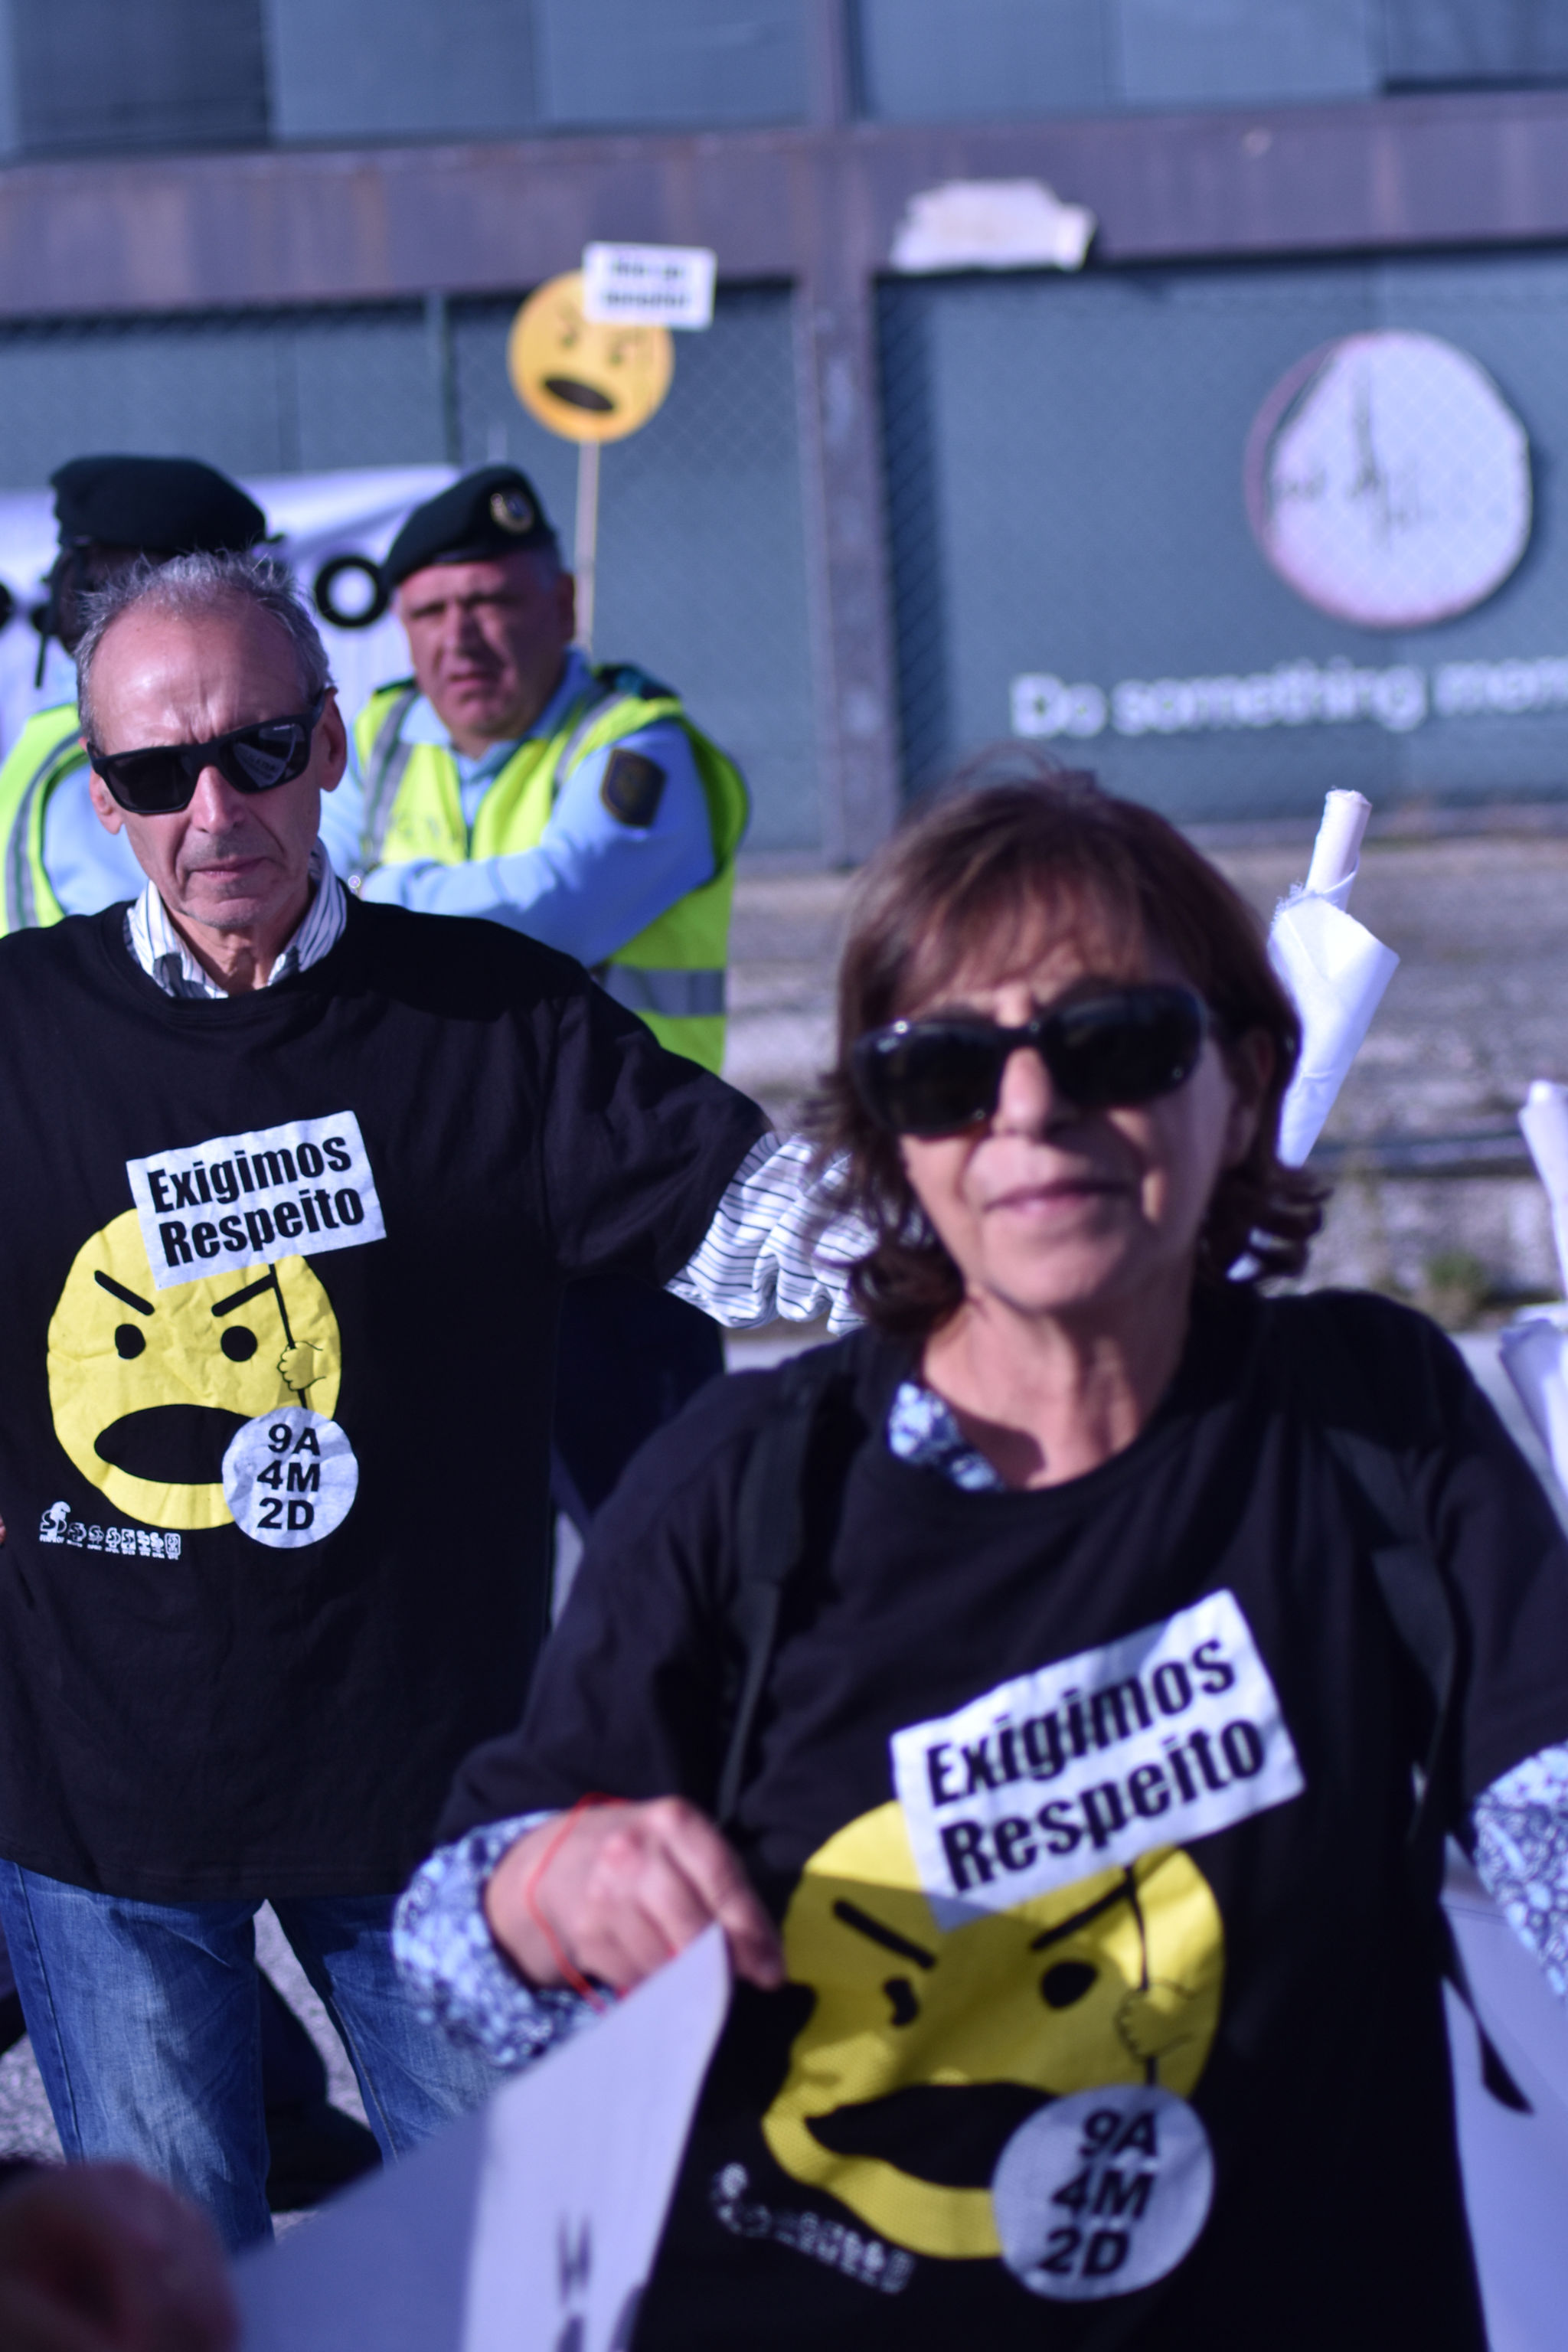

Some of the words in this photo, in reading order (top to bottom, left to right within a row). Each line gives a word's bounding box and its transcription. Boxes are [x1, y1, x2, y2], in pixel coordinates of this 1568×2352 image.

[1011, 674, 1106, 737] Do
[1112, 656, 1427, 734] something
[147, 1137, 352, 1214] Exigimos
[158, 1187, 364, 1268] Respeito
[268, 1423, 321, 1456] 9A
[256, 1459, 321, 1492] 4M
[256, 1497, 315, 1530] 2D
[926, 1638, 1236, 1808] Exigimos
[939, 1719, 1267, 1893] Respeito
[1079, 2107, 1158, 2158] 9A
[1050, 2167, 1156, 2220] 4M
[1036, 2225, 1130, 2278] 2D
